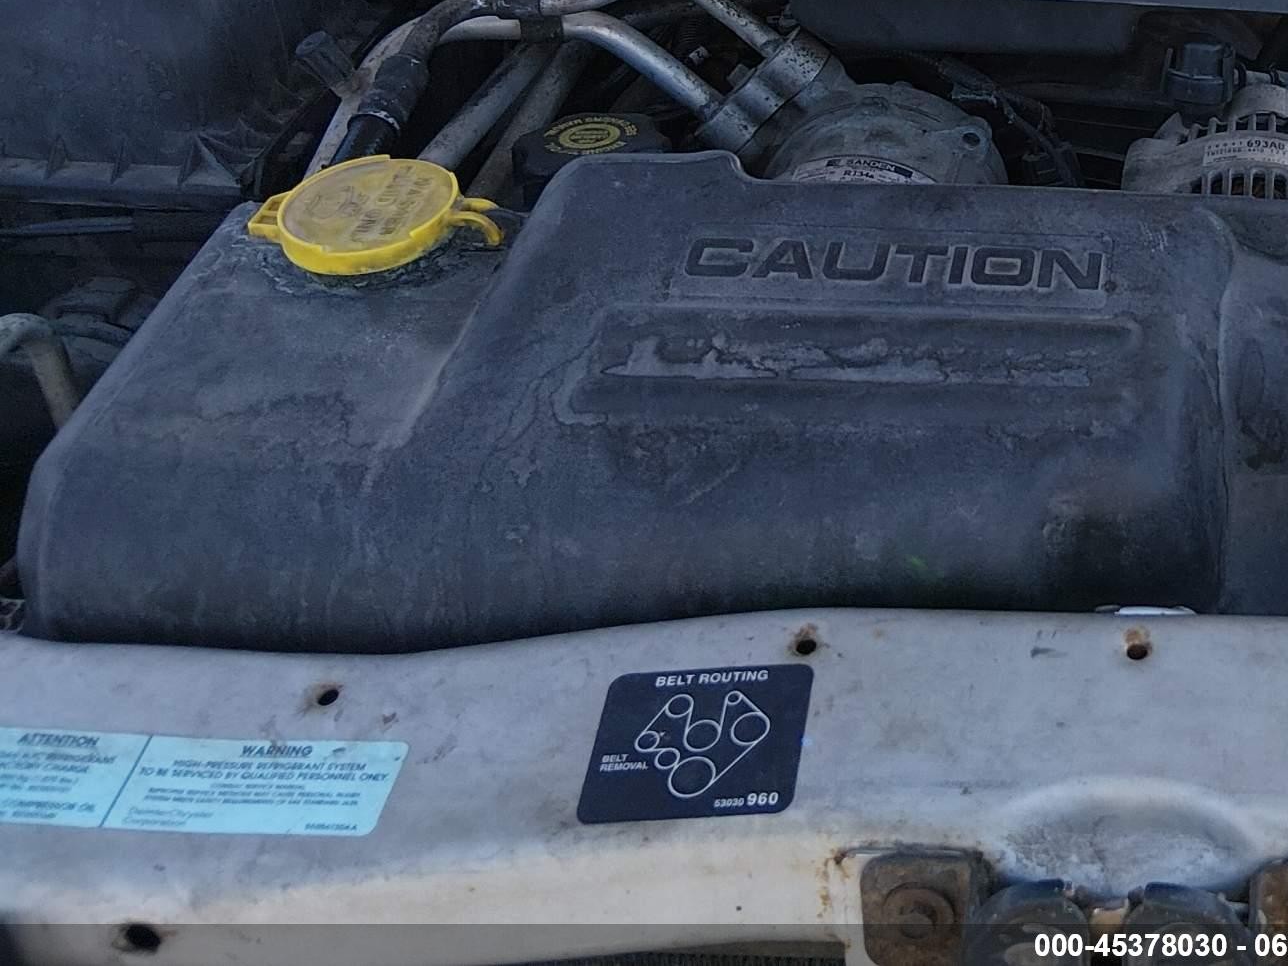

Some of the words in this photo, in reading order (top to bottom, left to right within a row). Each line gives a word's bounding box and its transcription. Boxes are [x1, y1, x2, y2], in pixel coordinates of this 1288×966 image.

[846, 158, 896, 172] SANDEN
[684, 237, 1104, 291] CAUTION
[655, 674, 695, 688] BELT
[699, 669, 769, 685] ROUTING
[17, 733, 100, 747] ATTENTION
[241, 745, 313, 757] WARNING
[601, 753, 629, 763] BELT
[327, 762, 367, 771] SYSTEM
[600, 761, 649, 772] REMOVAL
[140, 766, 155, 776] TO
[223, 772, 238, 780] BY
[296, 773, 356, 781] PERSONNEL
[359, 773, 389, 782] ONLY
[746, 792, 779, 806] 960
